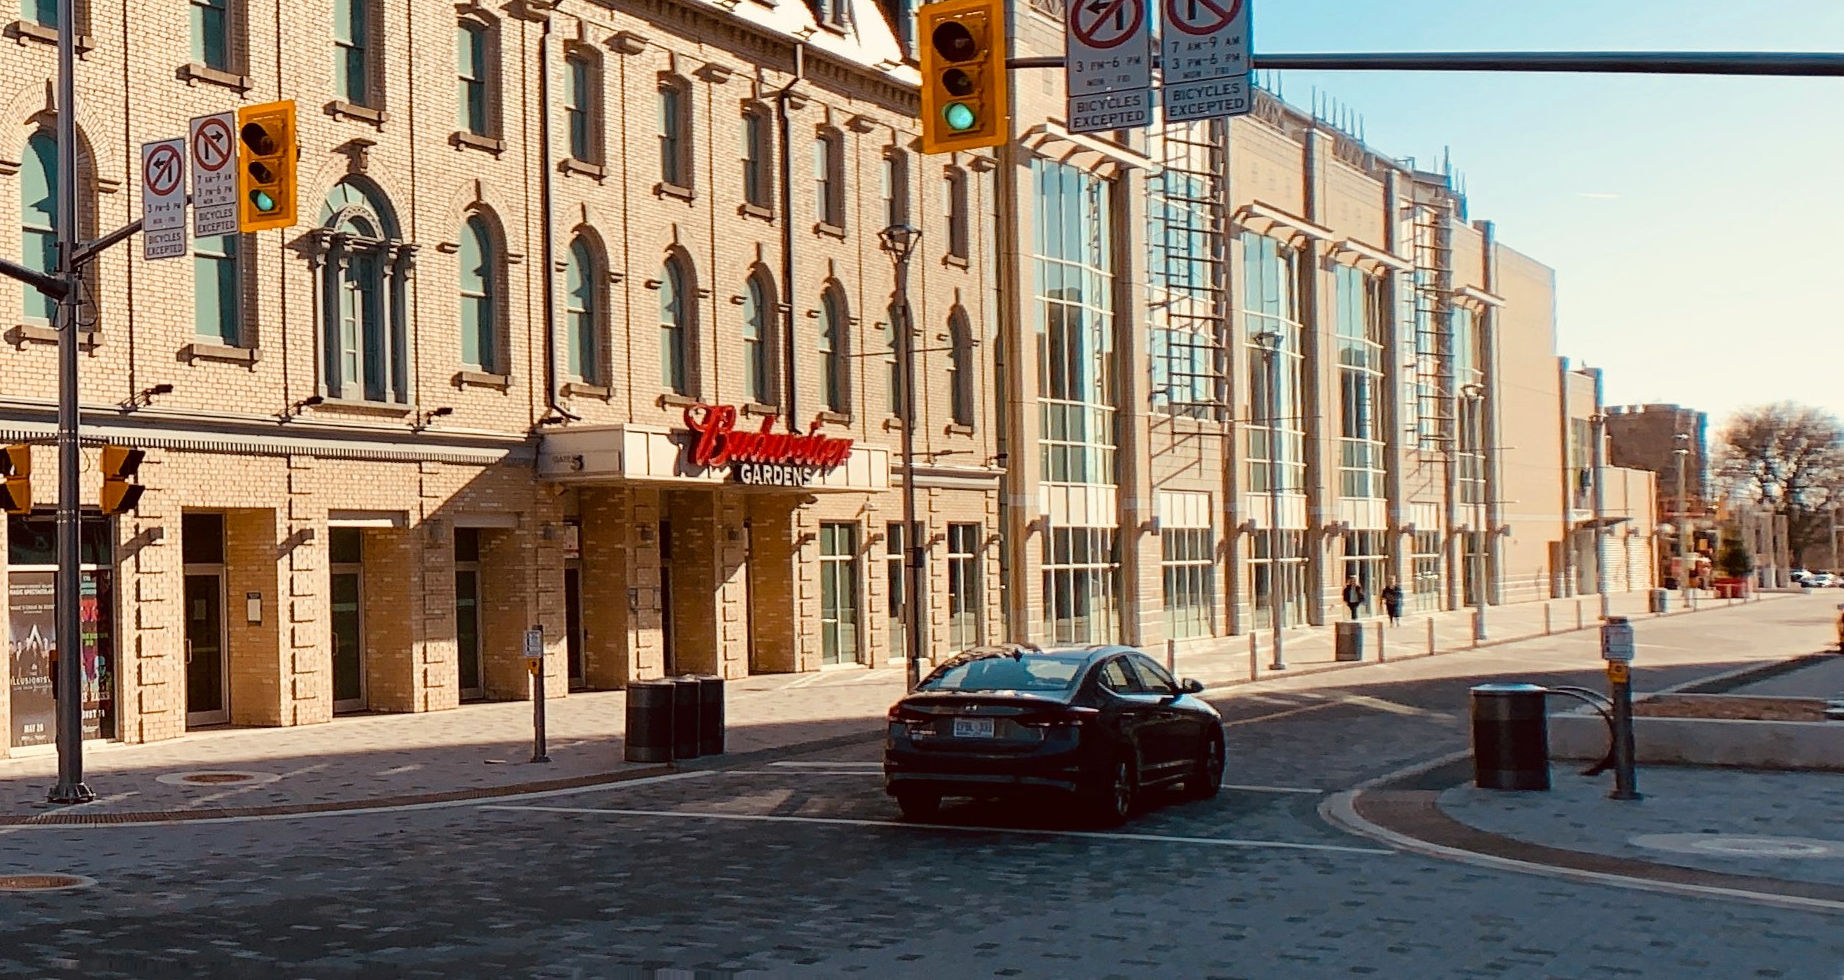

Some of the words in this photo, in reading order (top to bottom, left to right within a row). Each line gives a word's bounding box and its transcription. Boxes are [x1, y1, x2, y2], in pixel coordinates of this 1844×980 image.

[1171, 41, 1180, 53] 7
[1226, 36, 1240, 46] AM
[1076, 61, 1084, 72] 3
[1127, 56, 1141, 66] PM
[1172, 58, 1180, 69] 3
[1225, 53, 1240, 62] PM
[1173, 83, 1240, 101] BICYCLES
[1077, 95, 1141, 113] BICYCLES
[1170, 98, 1244, 116] EXCEPTED
[1074, 110, 1145, 128] EXCEPTED
[197, 175, 202, 184] 7
[198, 188, 202, 197] 3
[148, 204, 152, 213] 3
[199, 208, 233, 221] BICYCLES
[197, 220, 235, 233] EXCEPTED
[149, 232, 181, 245] BICYCLES
[147, 243, 183, 256] EXCEPTED
[684, 404, 854, 466] Budweiser
[570, 454, 584, 470] 3
[741, 463, 812, 486] GARDENS
[11, 676, 50, 685] ILLUSIONIS
[24, 723, 36, 733] MAY
